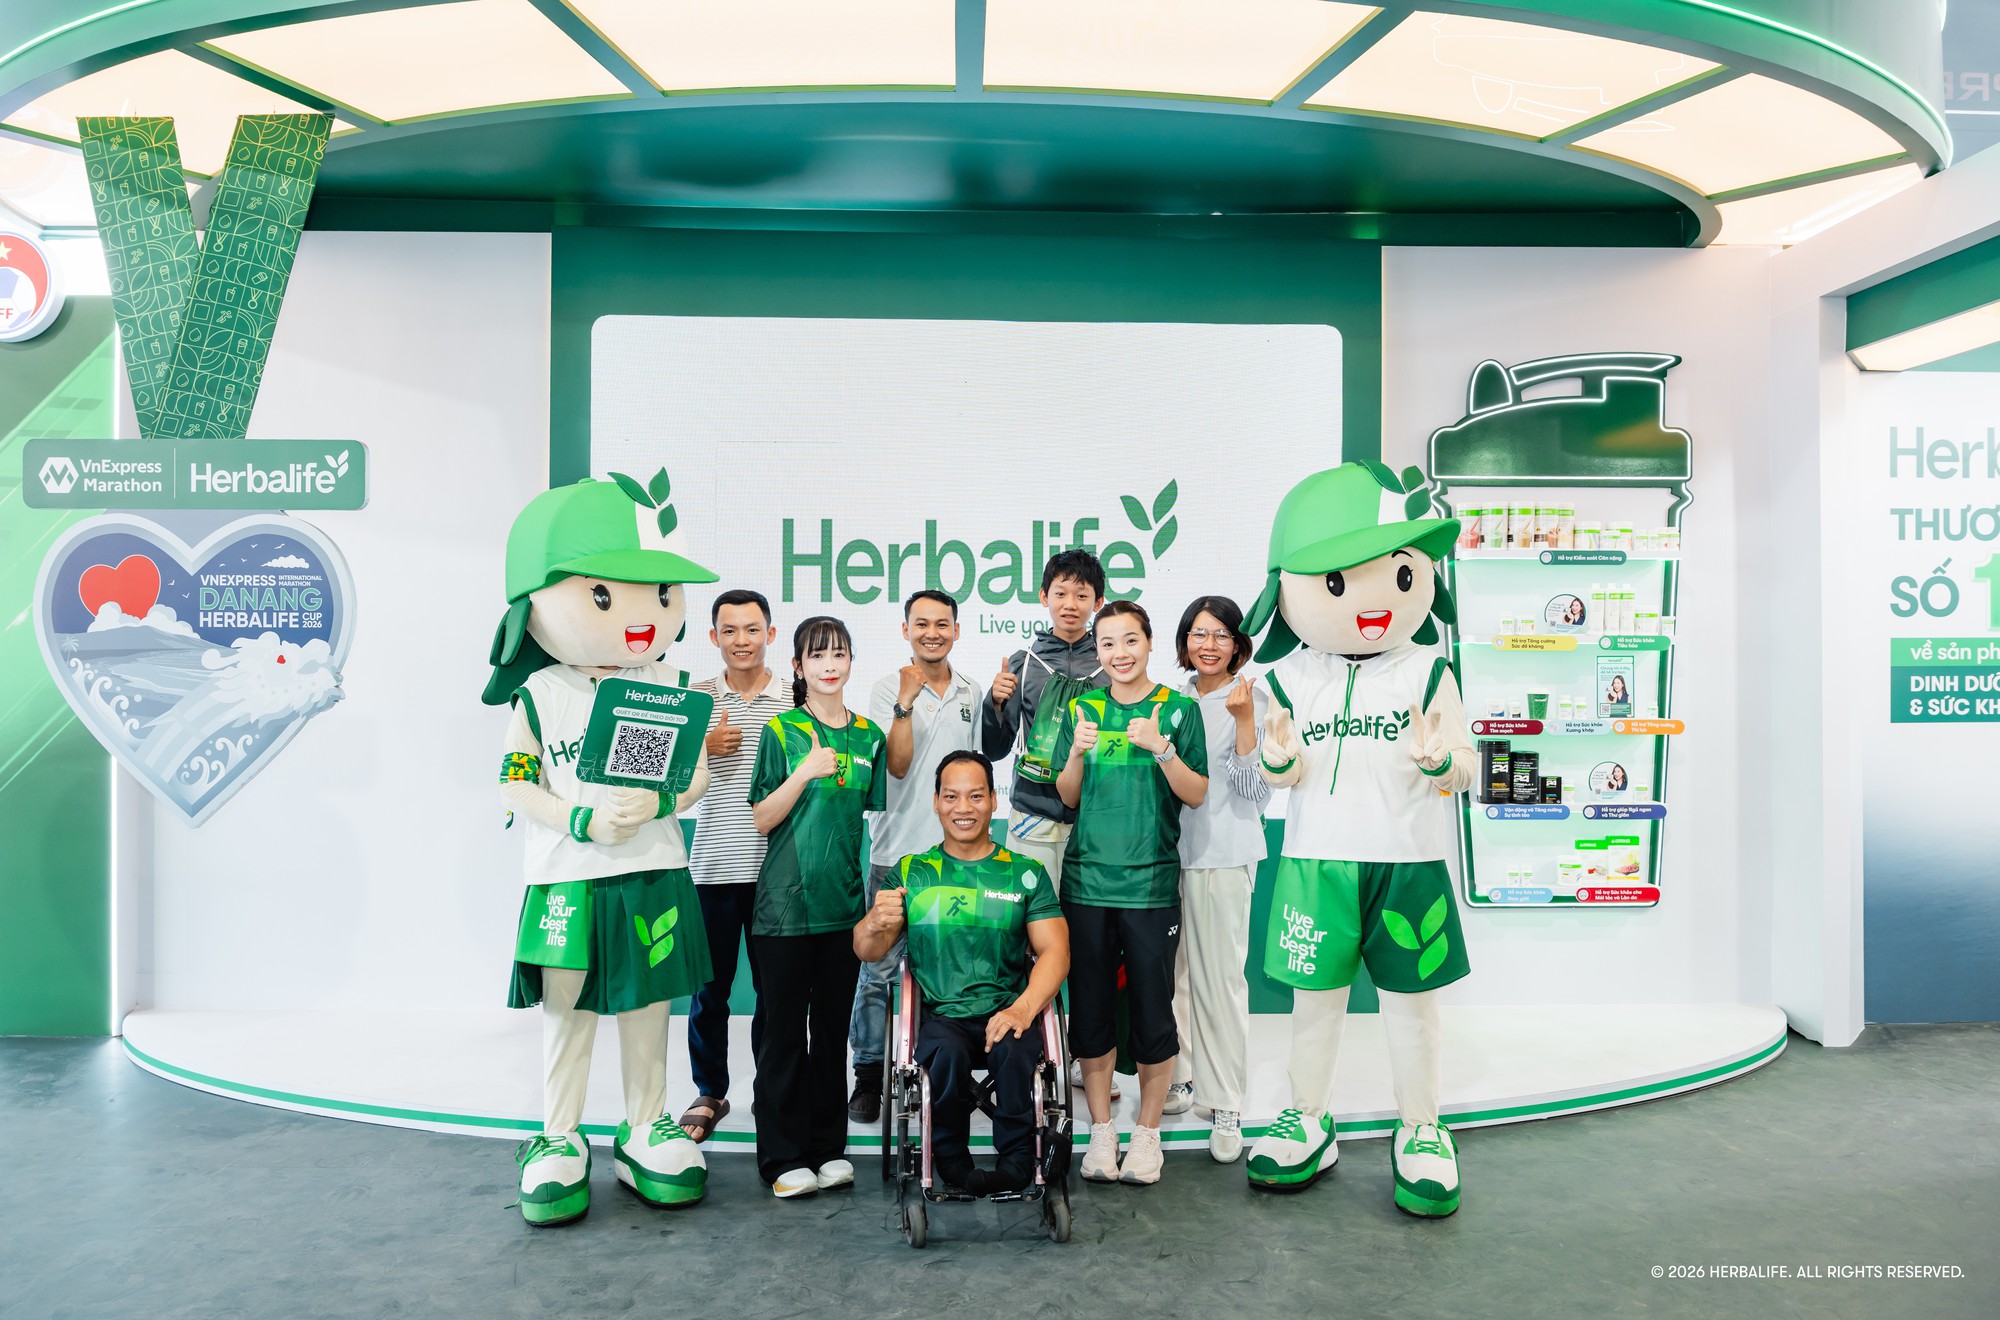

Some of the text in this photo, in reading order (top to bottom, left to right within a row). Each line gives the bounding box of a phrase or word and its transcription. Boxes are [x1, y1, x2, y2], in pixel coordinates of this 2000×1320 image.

[80, 459, 162, 476] VnExpress
[83, 478, 162, 492] Marathon
[190, 462, 336, 494] Herbalife
[200, 574, 277, 587] VNEXPRESS
[199, 587, 323, 612] DANANG
[1890, 552, 2000, 630] SỐ 1
[199, 611, 300, 628] HERBALIFE
[302, 612, 322, 621] CUP
[979, 614, 1016, 634] Live
[1910, 639, 1933, 660] về
[1937, 642, 1972, 660] sản
[1910, 675, 1959, 692] DINH
[625, 689, 680, 706] Herbalife
[1910, 698, 1923, 715] &
[1927, 695, 1970, 715] SỨC
[1302, 714, 1398, 746] Herbalife
[546, 892, 566, 906] Live
[984, 890, 1019, 902] Herbalife
[548, 905, 577, 920] your
[1283, 904, 1314, 929] Live
[539, 914, 568, 931] best
[546, 930, 567, 947] life
[1287, 921, 1328, 943] your
[1279, 930, 1317, 958] best
[1288, 952, 1316, 975] life
